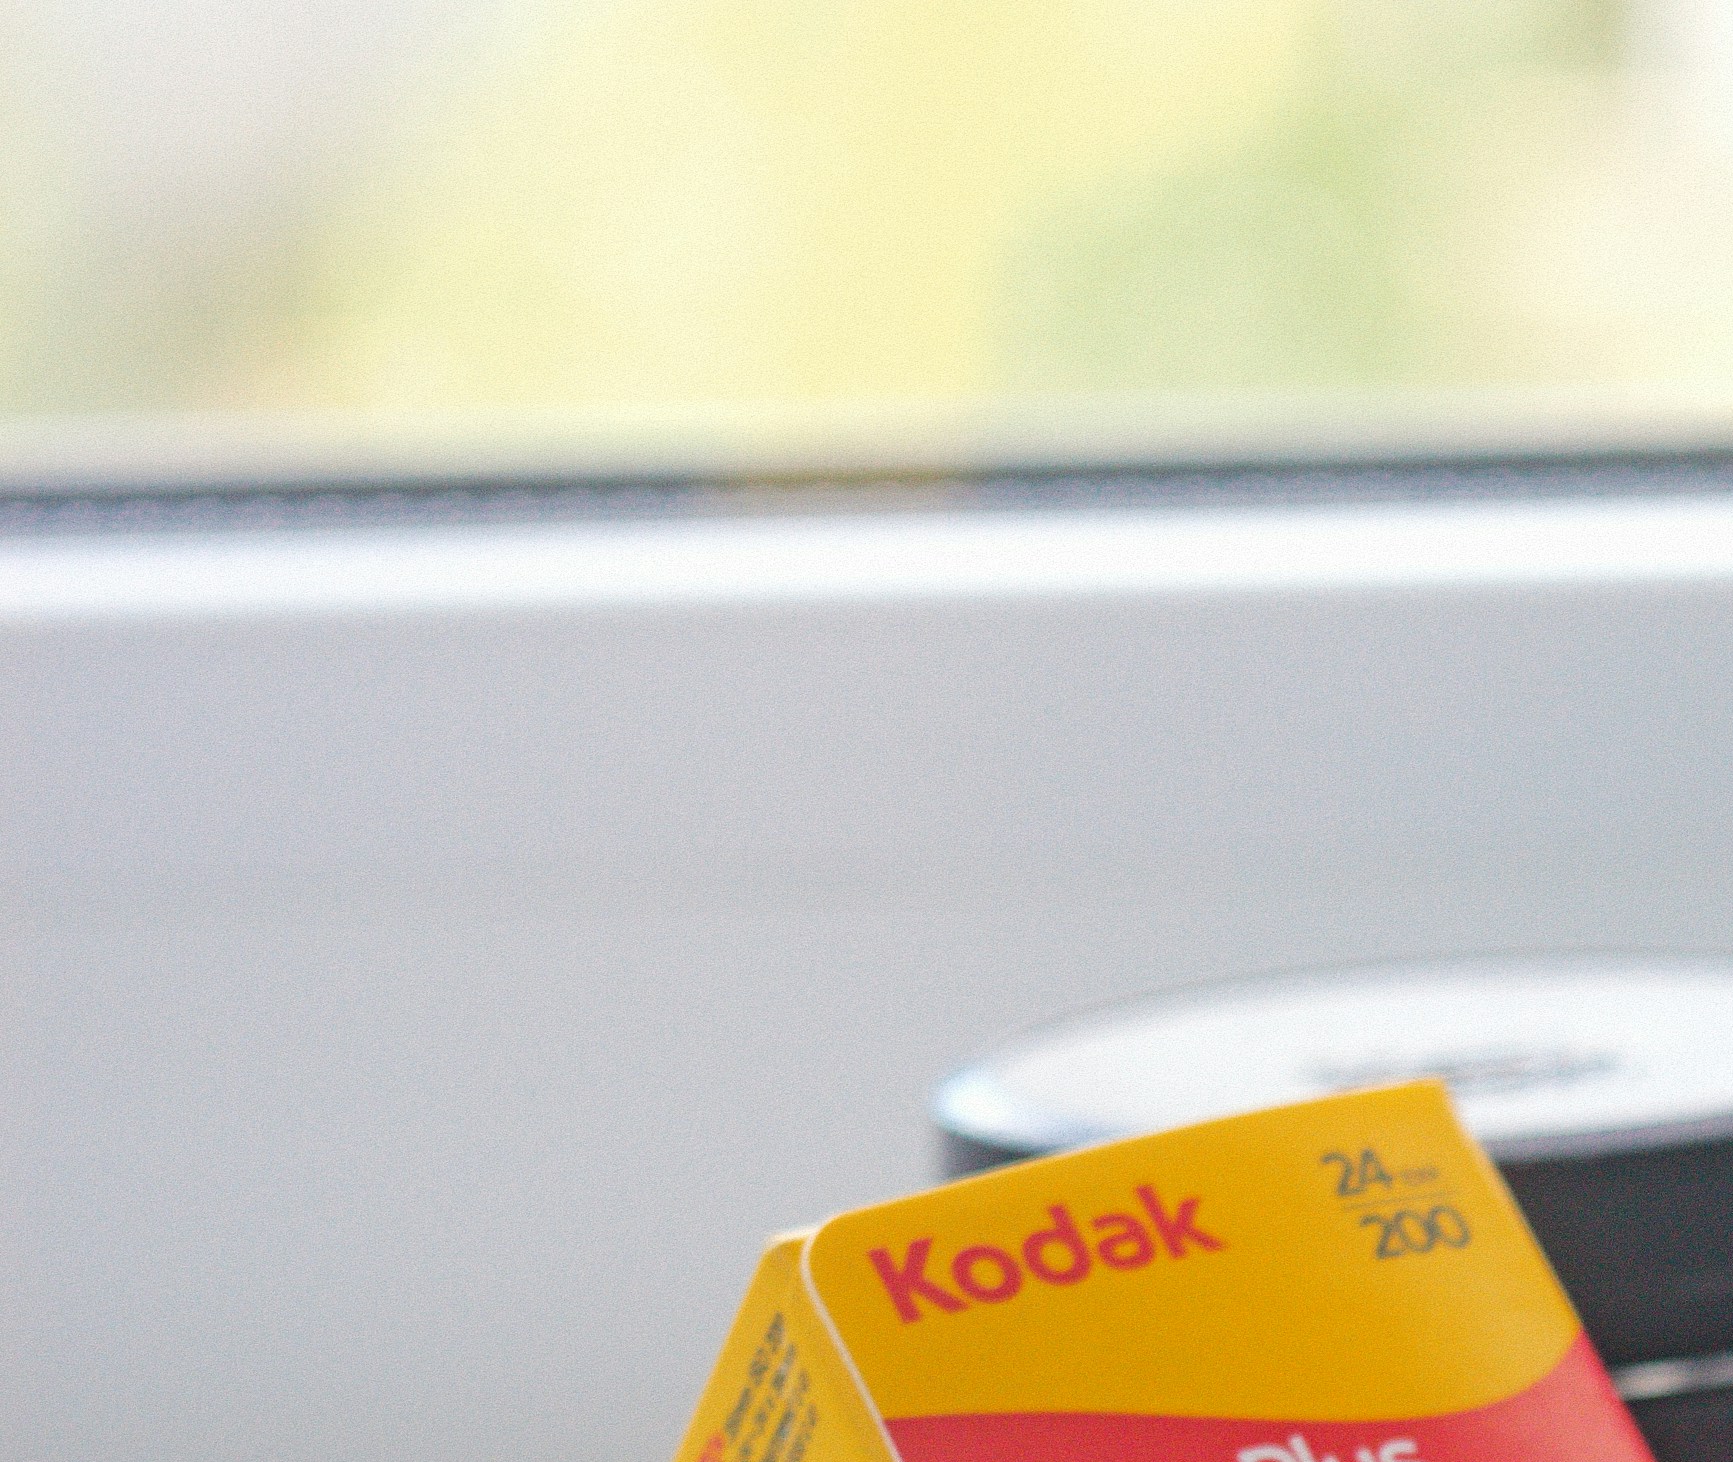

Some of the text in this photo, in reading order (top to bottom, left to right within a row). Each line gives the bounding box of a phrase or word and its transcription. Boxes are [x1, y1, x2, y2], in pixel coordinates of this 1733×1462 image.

[1320, 1147, 1393, 1198] 24
[867, 1184, 1227, 1325] Kodak
[1360, 1204, 1471, 1260] 200
